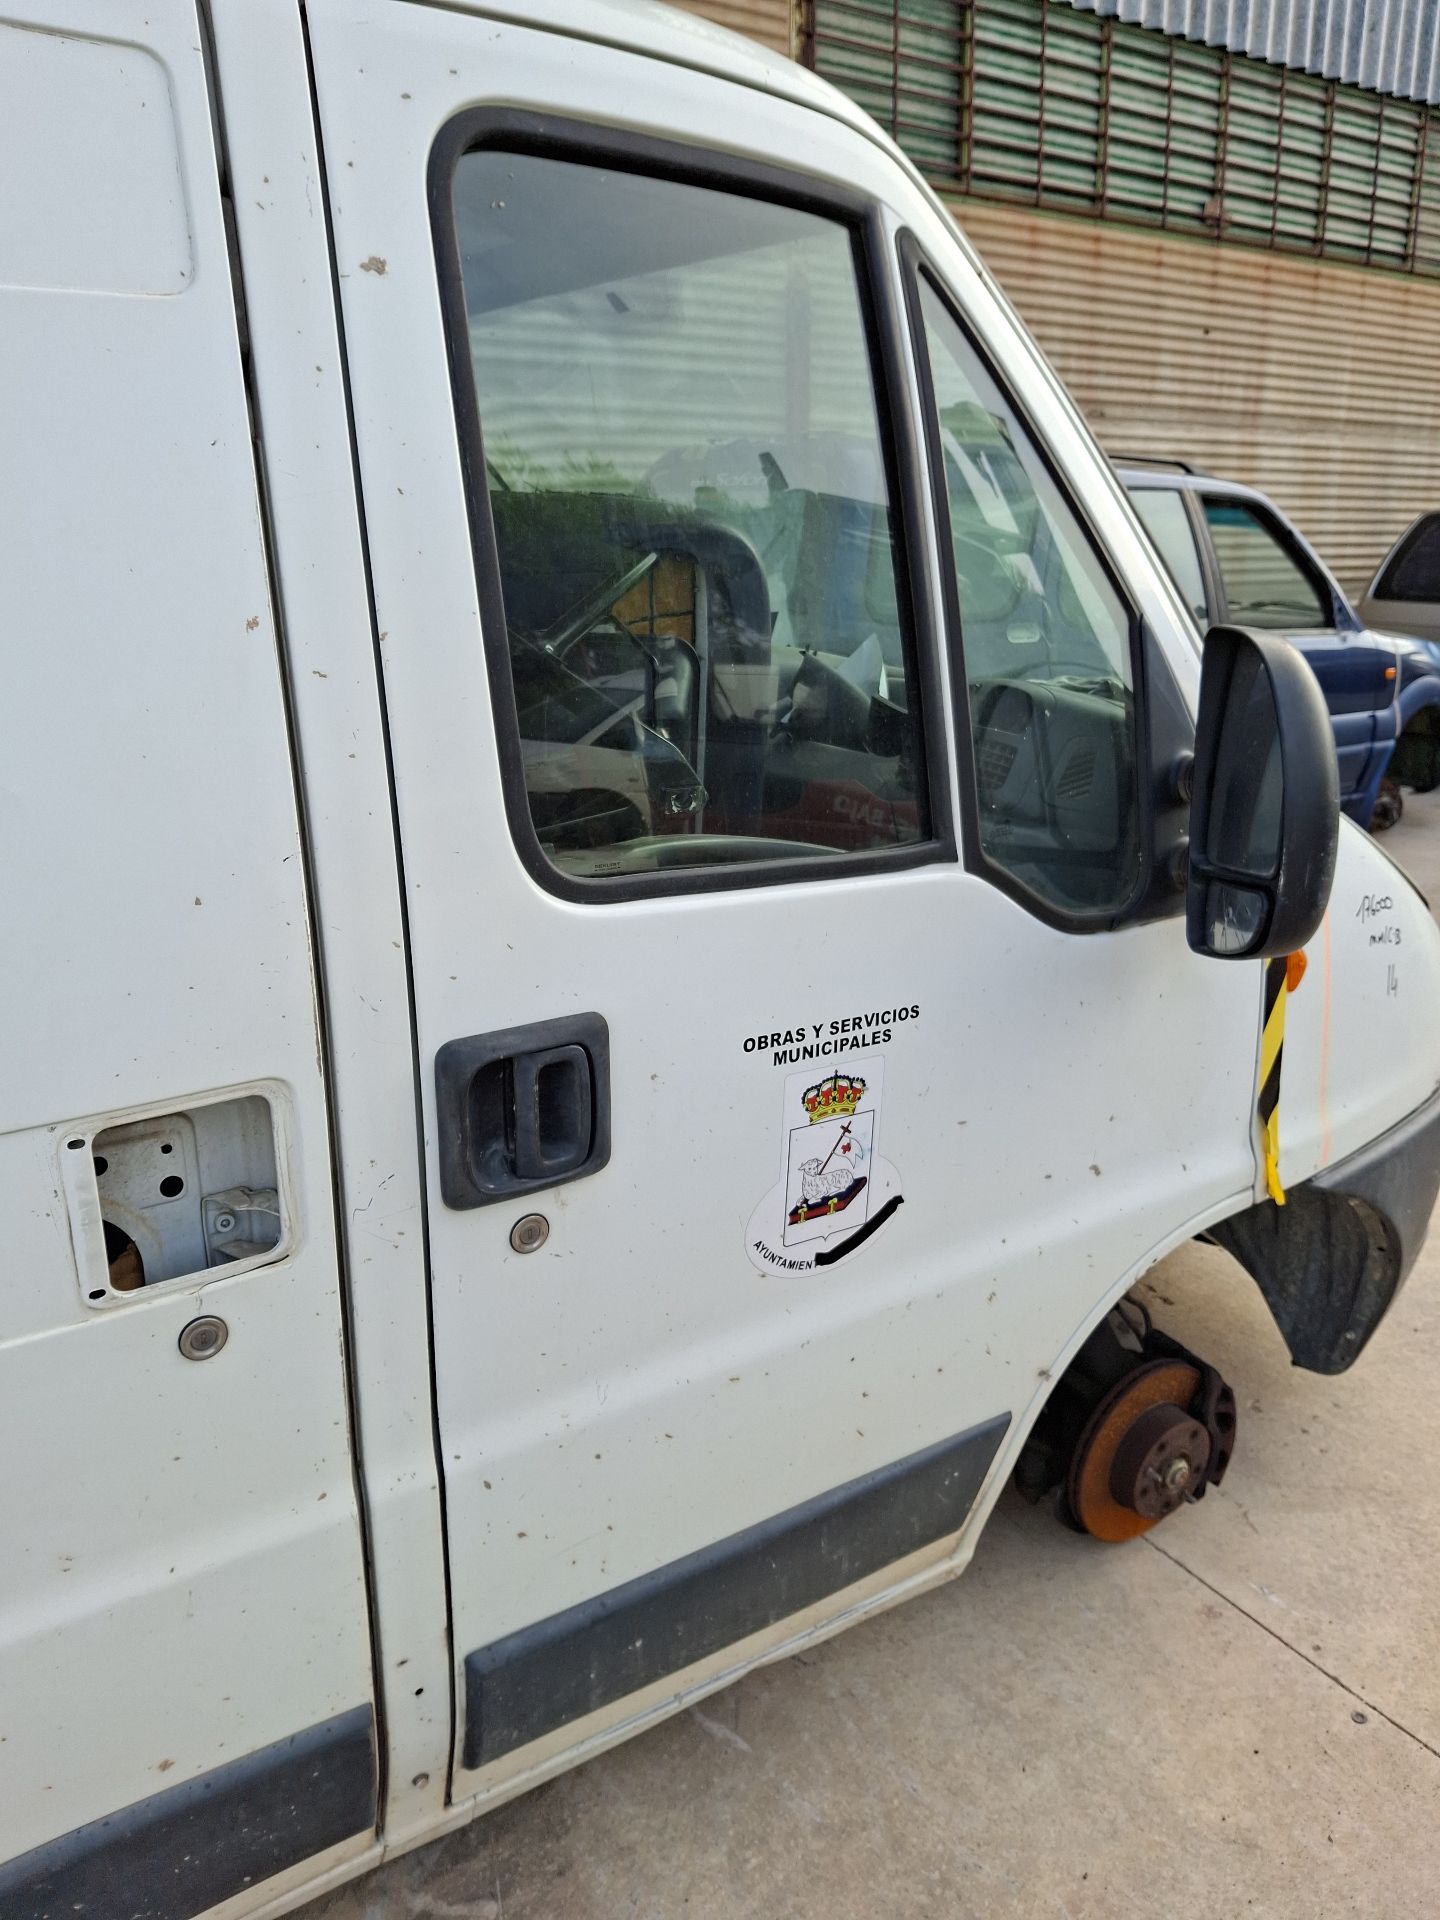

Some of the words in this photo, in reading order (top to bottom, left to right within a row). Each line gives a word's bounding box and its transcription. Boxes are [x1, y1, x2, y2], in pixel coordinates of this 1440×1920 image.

[742, 1027, 806, 1053] OBRAS
[812, 1023, 824, 1038] Y
[829, 1004, 920, 1036] SERVICIOS
[773, 1028, 892, 1067] MUNICIPALES
